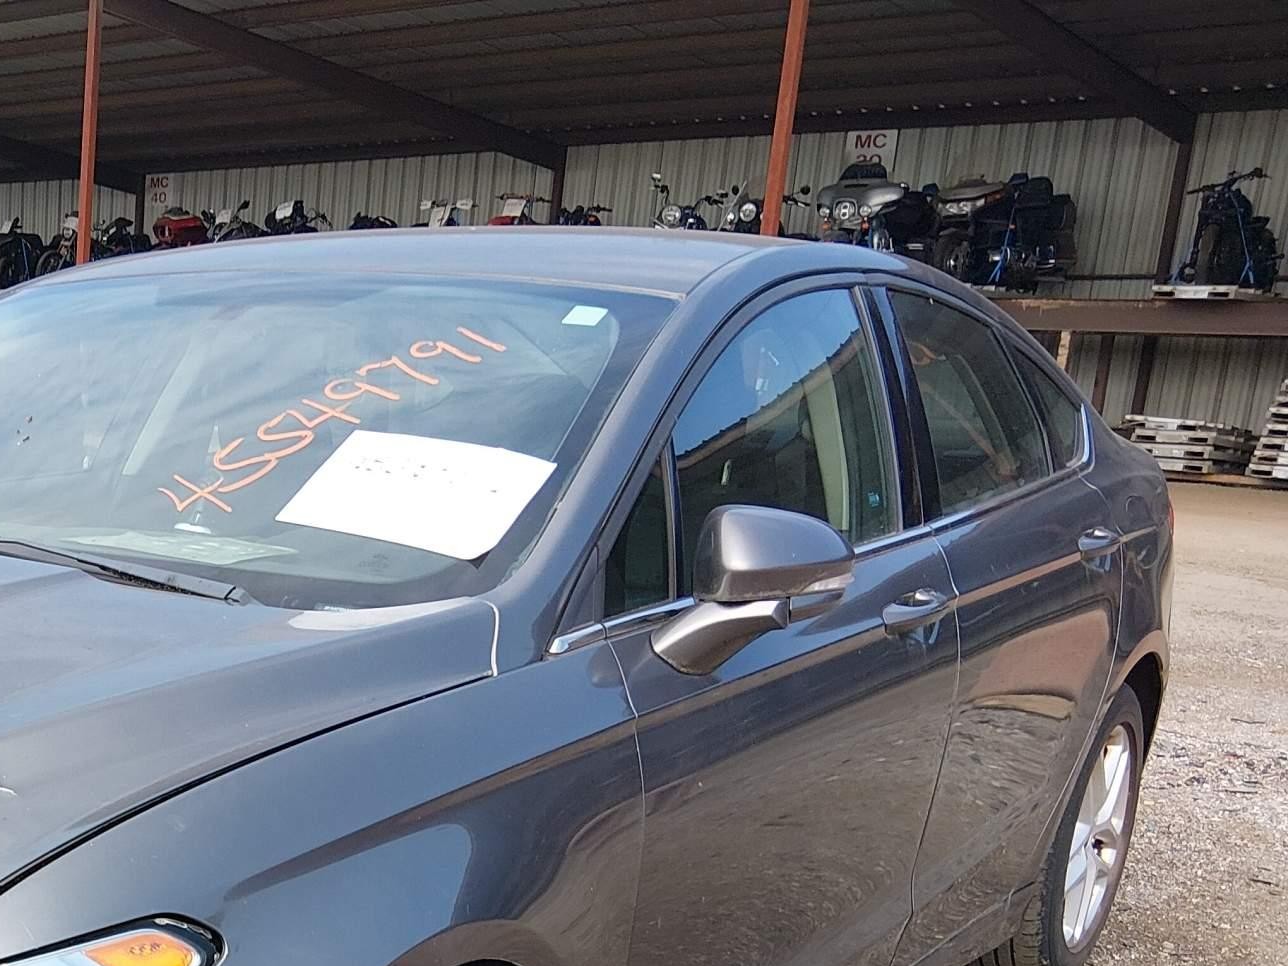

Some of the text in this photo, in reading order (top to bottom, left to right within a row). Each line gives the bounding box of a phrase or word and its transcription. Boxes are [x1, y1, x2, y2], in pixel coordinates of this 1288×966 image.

[854, 133, 888, 149] MC
[150, 176, 169, 189] MC
[152, 191, 167, 204] 40
[158, 325, 507, 513] 45549791
